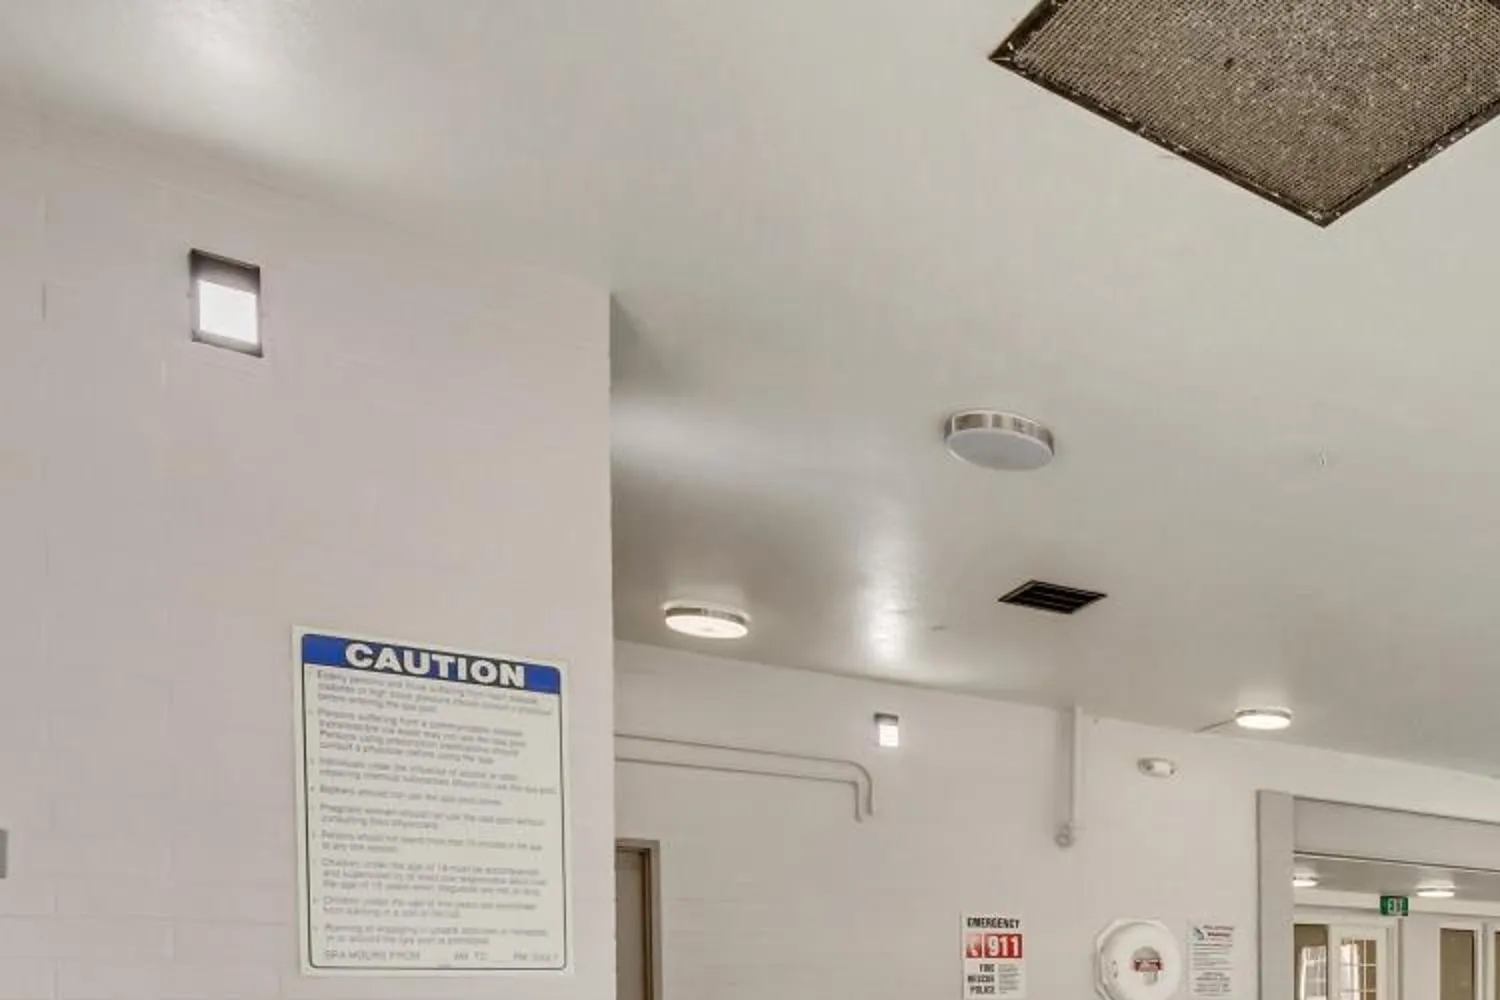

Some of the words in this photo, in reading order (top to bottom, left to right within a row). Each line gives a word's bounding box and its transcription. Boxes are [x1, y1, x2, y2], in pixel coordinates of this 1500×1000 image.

[345, 641, 525, 688] CAUTION
[967, 917, 1020, 929] EMERGENCY
[988, 935, 1020, 957] 911
